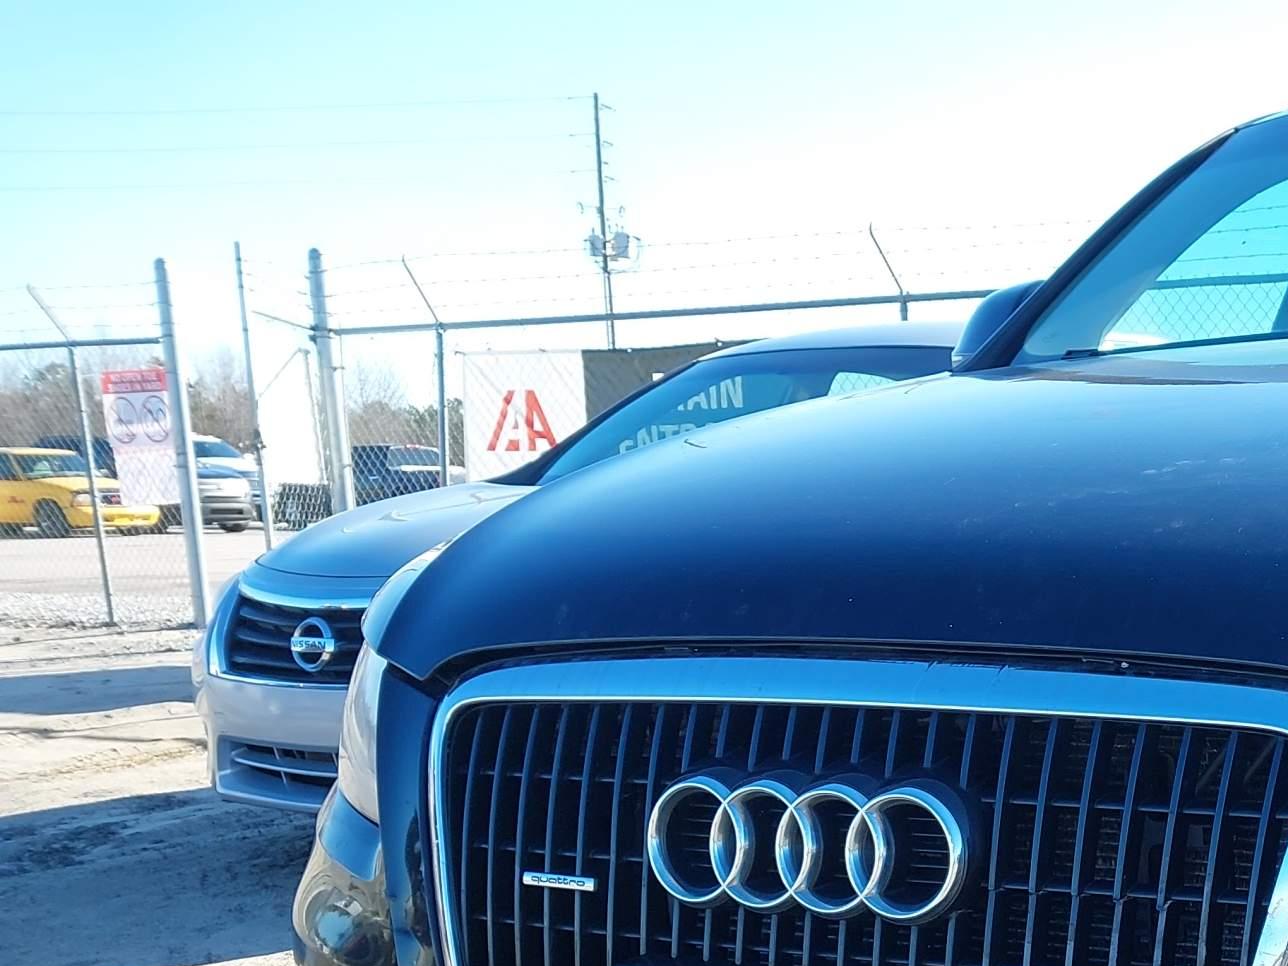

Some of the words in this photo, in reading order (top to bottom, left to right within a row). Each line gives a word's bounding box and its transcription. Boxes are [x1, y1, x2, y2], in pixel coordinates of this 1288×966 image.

[675, 374, 745, 411] AIN
[291, 639, 327, 650] NISSAN
[530, 874, 587, 887] quattro
